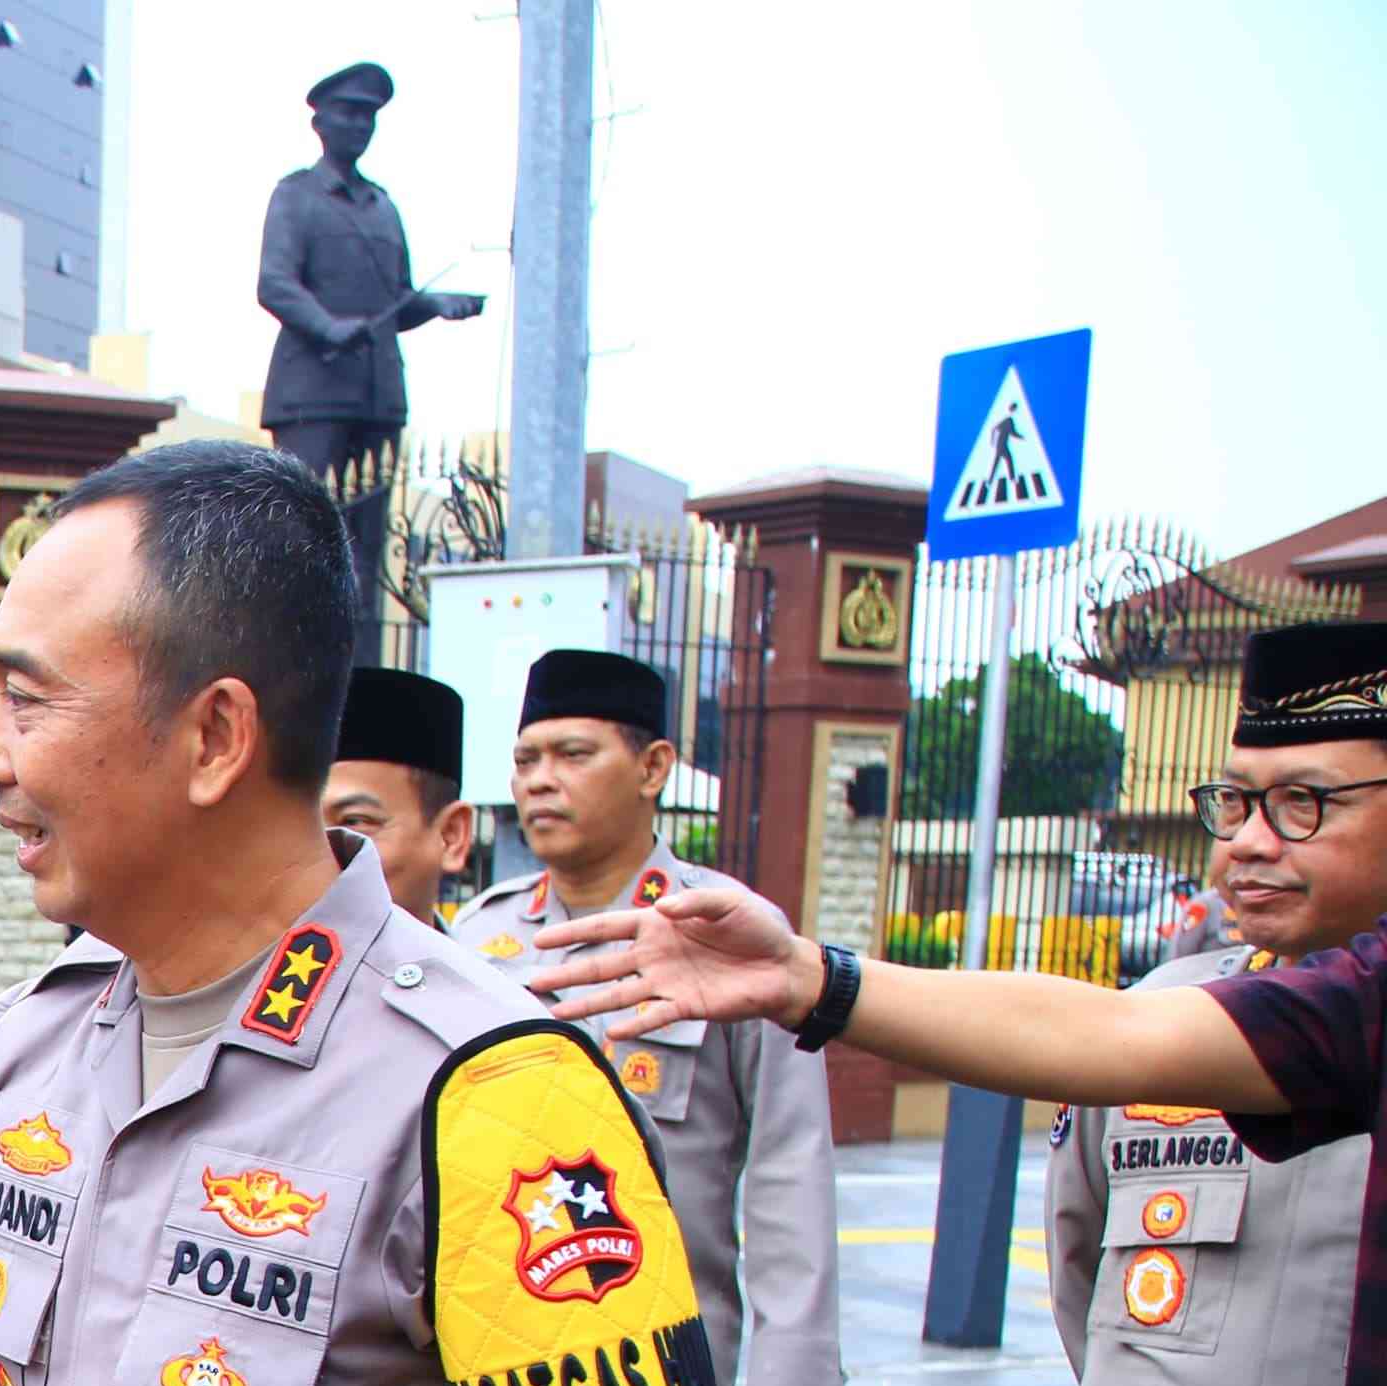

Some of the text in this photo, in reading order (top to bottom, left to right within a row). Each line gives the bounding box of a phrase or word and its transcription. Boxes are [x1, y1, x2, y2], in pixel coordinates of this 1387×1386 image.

[166, 1240, 313, 1323] POLRI
[526, 1236, 634, 1286] MABES POLRI
